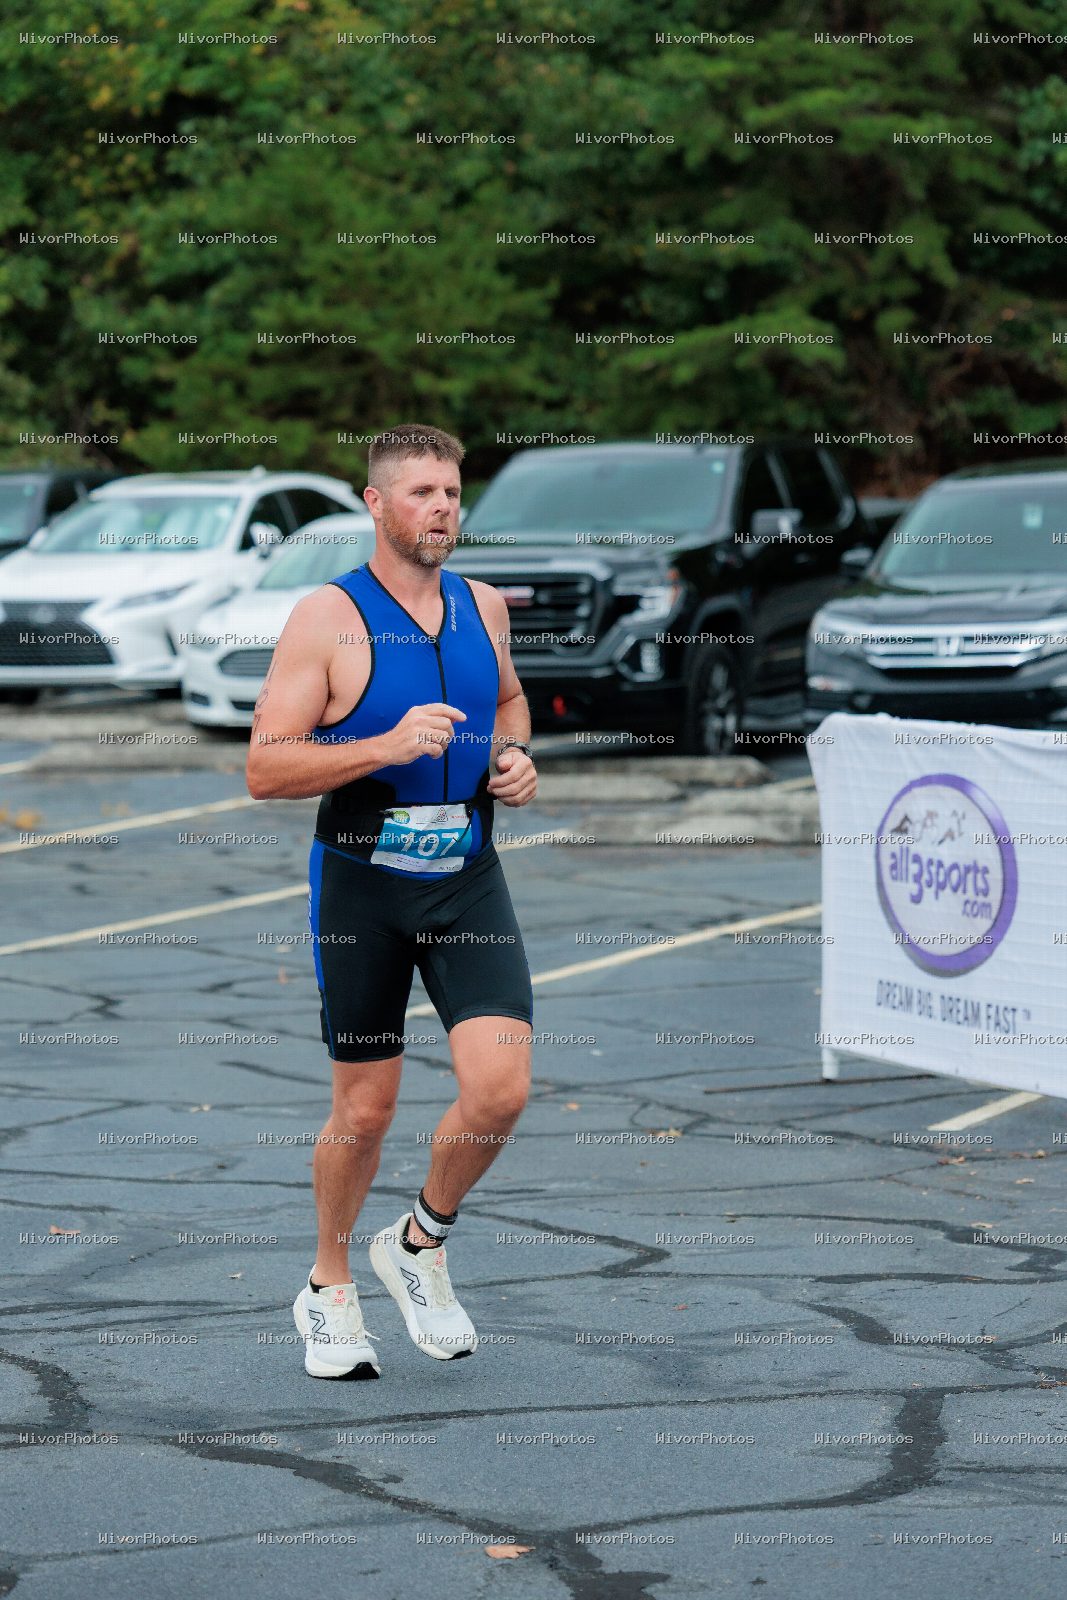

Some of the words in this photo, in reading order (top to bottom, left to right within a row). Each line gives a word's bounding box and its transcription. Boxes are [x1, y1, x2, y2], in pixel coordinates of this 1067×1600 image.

[401, 832, 459, 857] 107
[888, 846, 990, 905] all3sports
[876, 979, 913, 1014] DREAM
[940, 994, 981, 1029] DREAM
